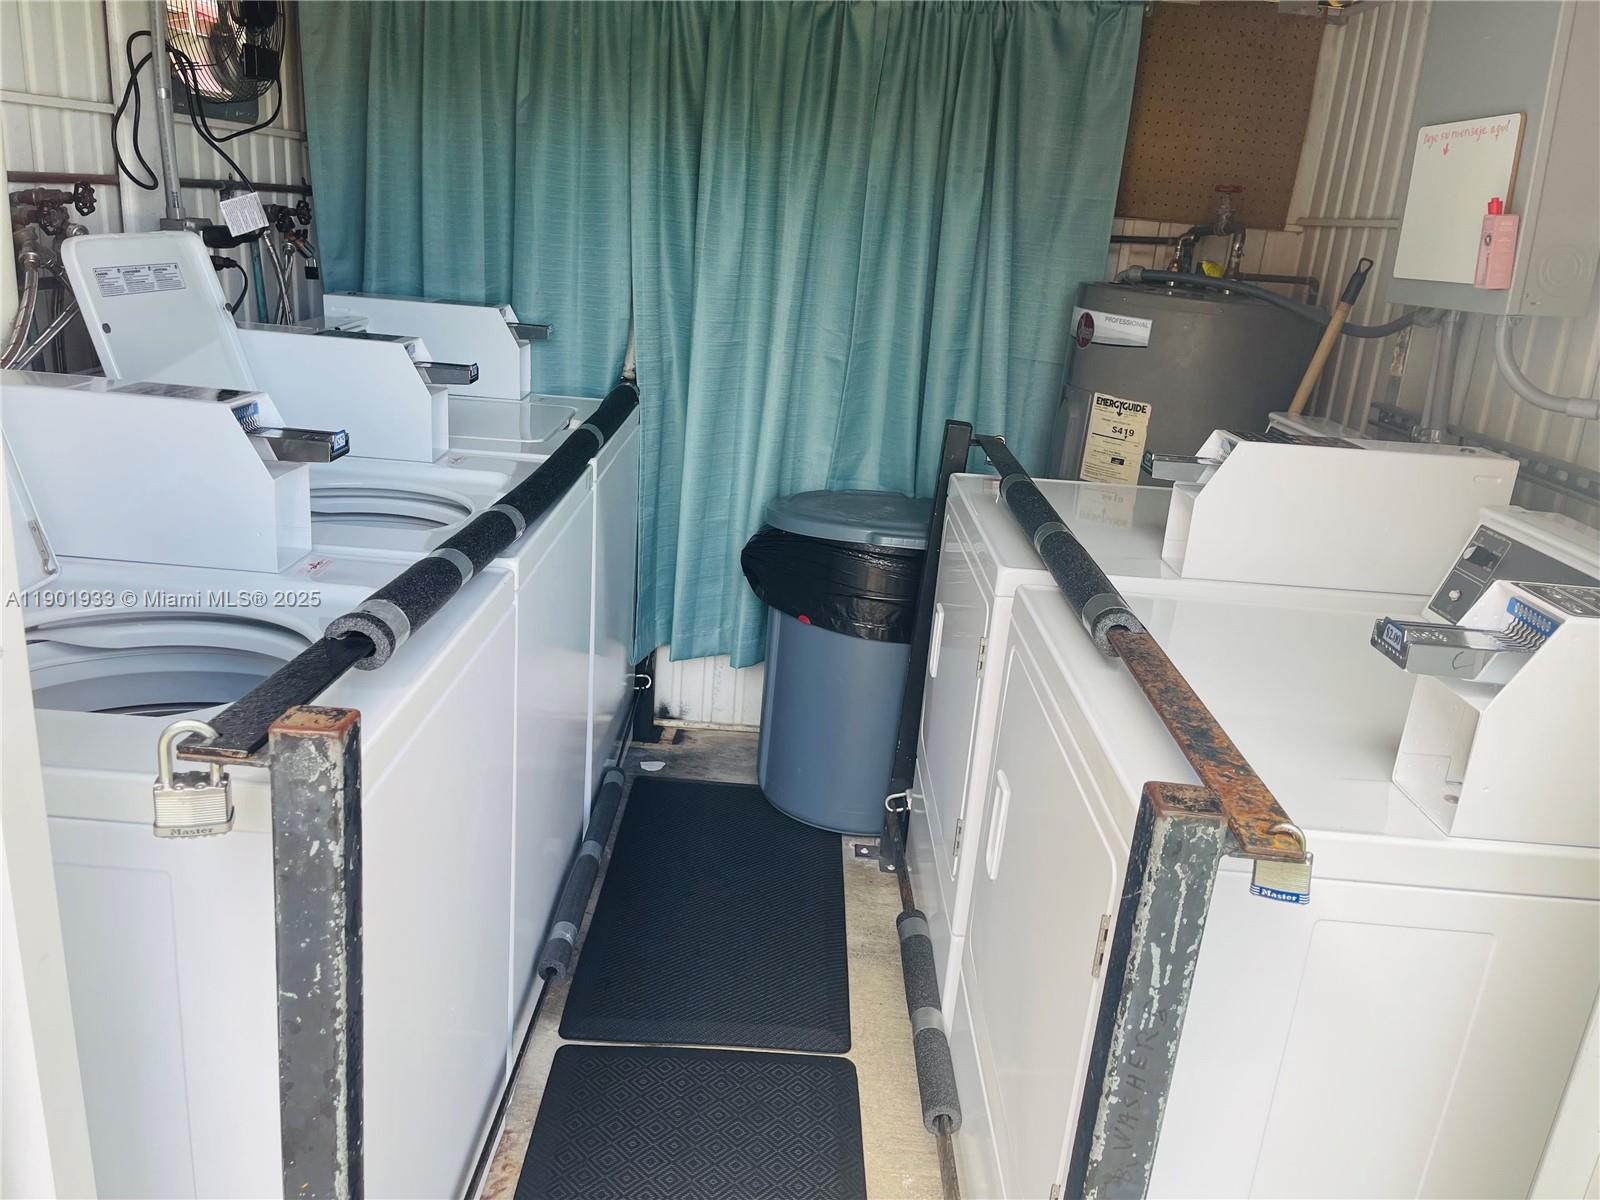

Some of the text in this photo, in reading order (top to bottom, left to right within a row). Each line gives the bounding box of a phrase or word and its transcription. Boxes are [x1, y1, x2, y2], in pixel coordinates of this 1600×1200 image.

[1104, 316, 1150, 329] PROFESSIONAL
[170, 827, 214, 836] Master
[1260, 888, 1299, 902] Master
